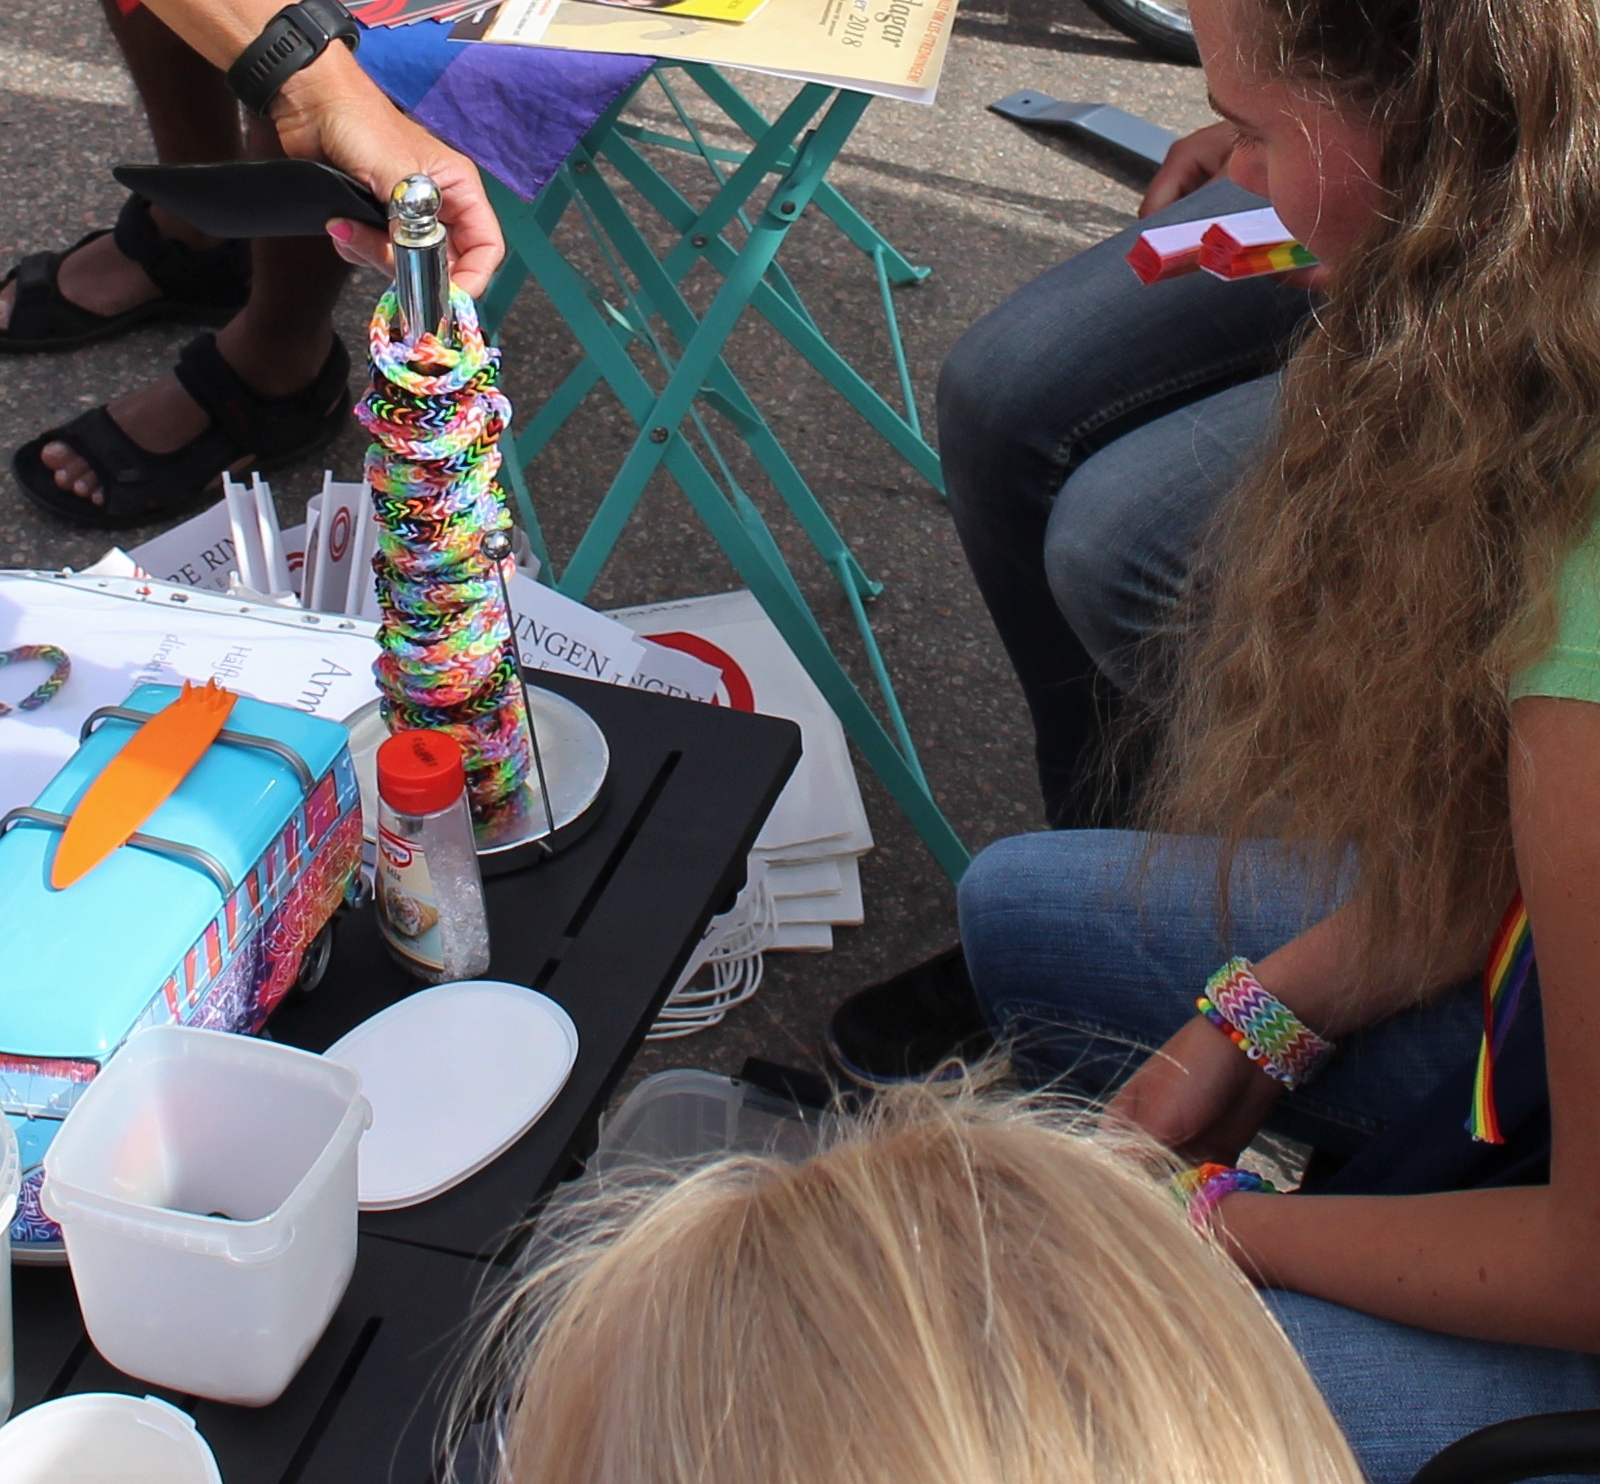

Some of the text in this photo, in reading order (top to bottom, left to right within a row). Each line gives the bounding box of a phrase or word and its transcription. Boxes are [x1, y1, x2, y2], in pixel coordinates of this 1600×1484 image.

[841, 12, 870, 49] 2018
[513, 612, 611, 679] INGEN
[296, 658, 353, 714] Arm
[386, 865, 402, 883] Mix
